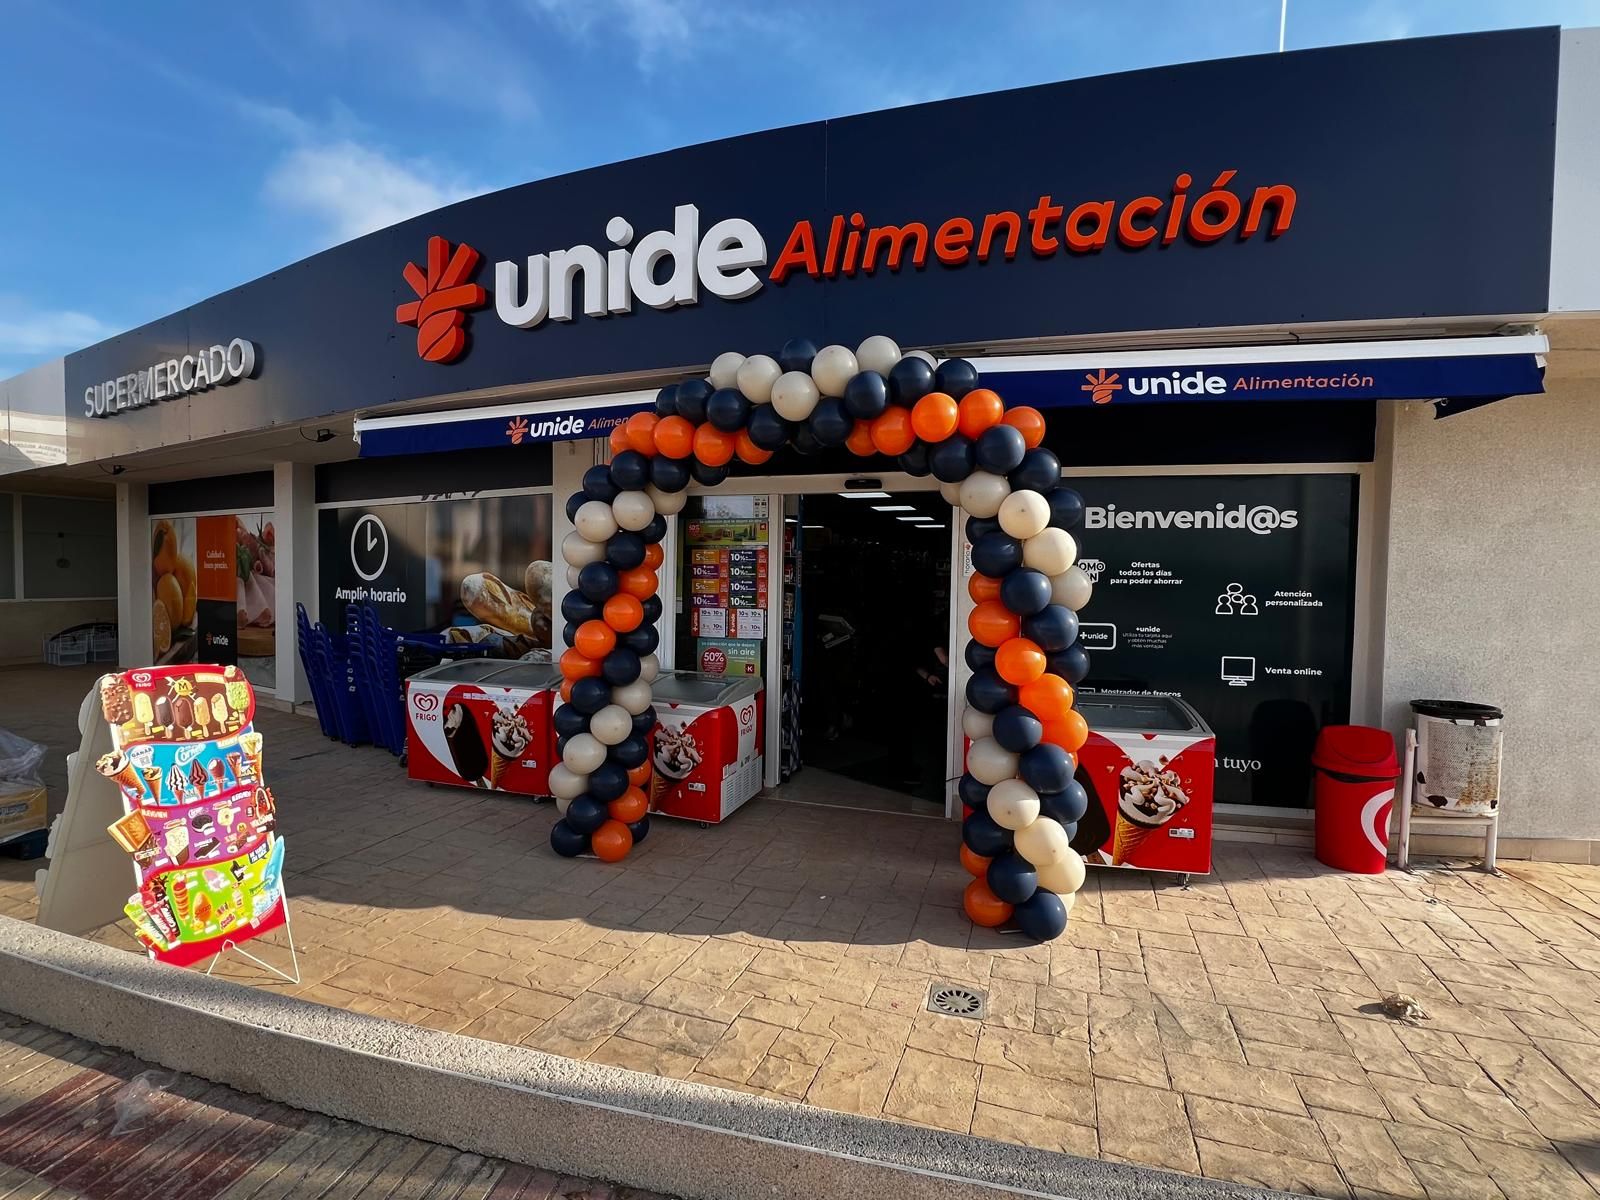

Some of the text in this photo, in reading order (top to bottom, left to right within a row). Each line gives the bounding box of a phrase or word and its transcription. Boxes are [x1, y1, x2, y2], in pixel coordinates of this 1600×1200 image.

[495, 168, 1298, 329] unide Alimentación
[84, 337, 254, 417] SUPERMERCADO
[1128, 371, 1375, 396] unide Alimentación
[530, 415, 629, 438] unide Alimen
[1084, 503, 1299, 535] Bienvenid@s
[1131, 561, 1160, 569] Ofertas
[1153, 569, 1172, 577] días
[1128, 577, 1147, 586] poder
[1148, 577, 1183, 586] ahorrar
[370, 587, 407, 603] horario
[1274, 590, 1312, 599] Atención
[1265, 599, 1323, 608] personalizada
[212, 635, 229, 646] unide
[1079, 631, 1109, 641] +unide
[728, 647, 755, 656] sin aire
[703, 652, 725, 662] 50%
[1265, 667, 1323, 676] Venta online
[415, 712, 437, 721] FRIGO
[740, 724, 753, 737] FRIGO
[1223, 756, 1262, 773] tuyo
